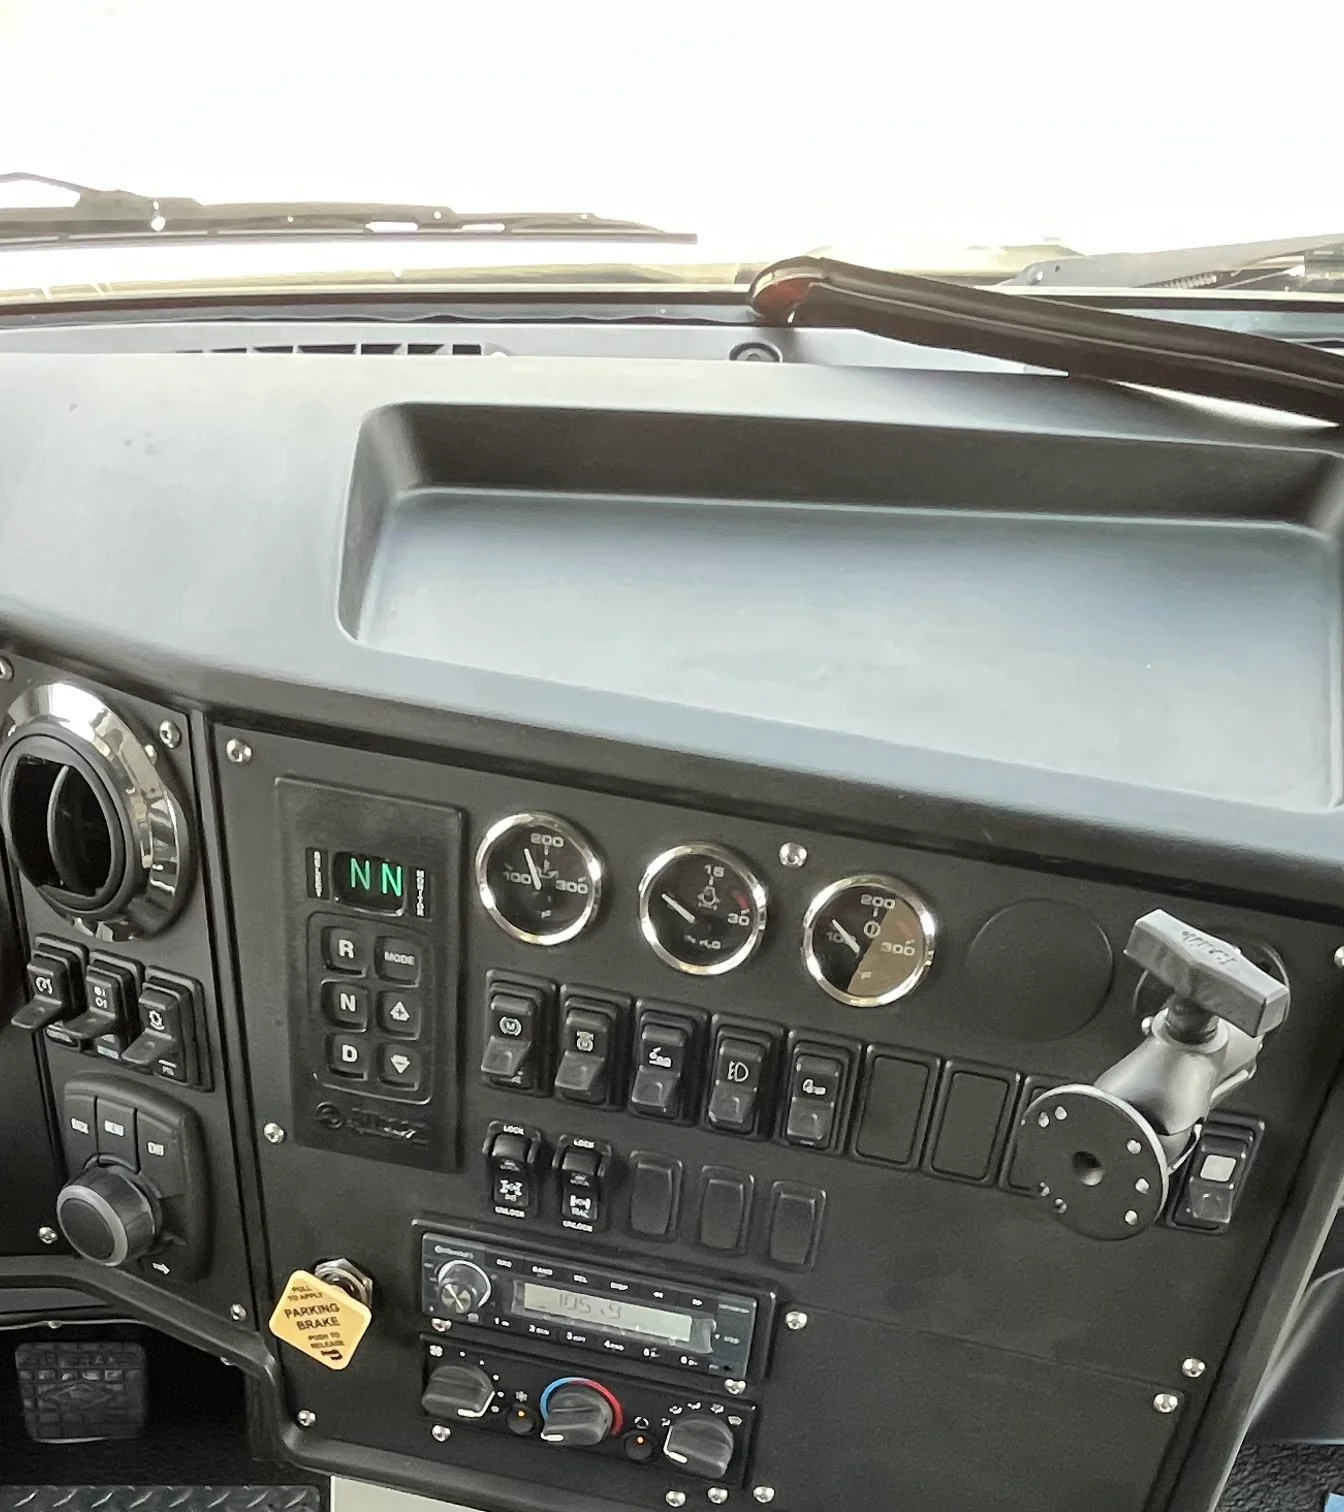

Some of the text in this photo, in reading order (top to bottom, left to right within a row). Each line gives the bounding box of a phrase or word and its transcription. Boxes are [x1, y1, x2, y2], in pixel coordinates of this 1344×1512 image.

[530, 832, 565, 848] 200
[350, 857, 403, 897] N N
[502, 870, 532, 885] 100
[555, 879, 589, 894] 300
[860, 893, 896, 909] 200
[727, 912, 751, 926] 30
[338, 938, 416, 966] R MODE
[880, 941, 916, 956] 300
[339, 992, 357, 1012] N
[341, 1044, 358, 1063] D
[299, 1292, 324, 1301] APPLY
[284, 1302, 341, 1319] PARKING
[296, 1316, 341, 1331] BRAKE
